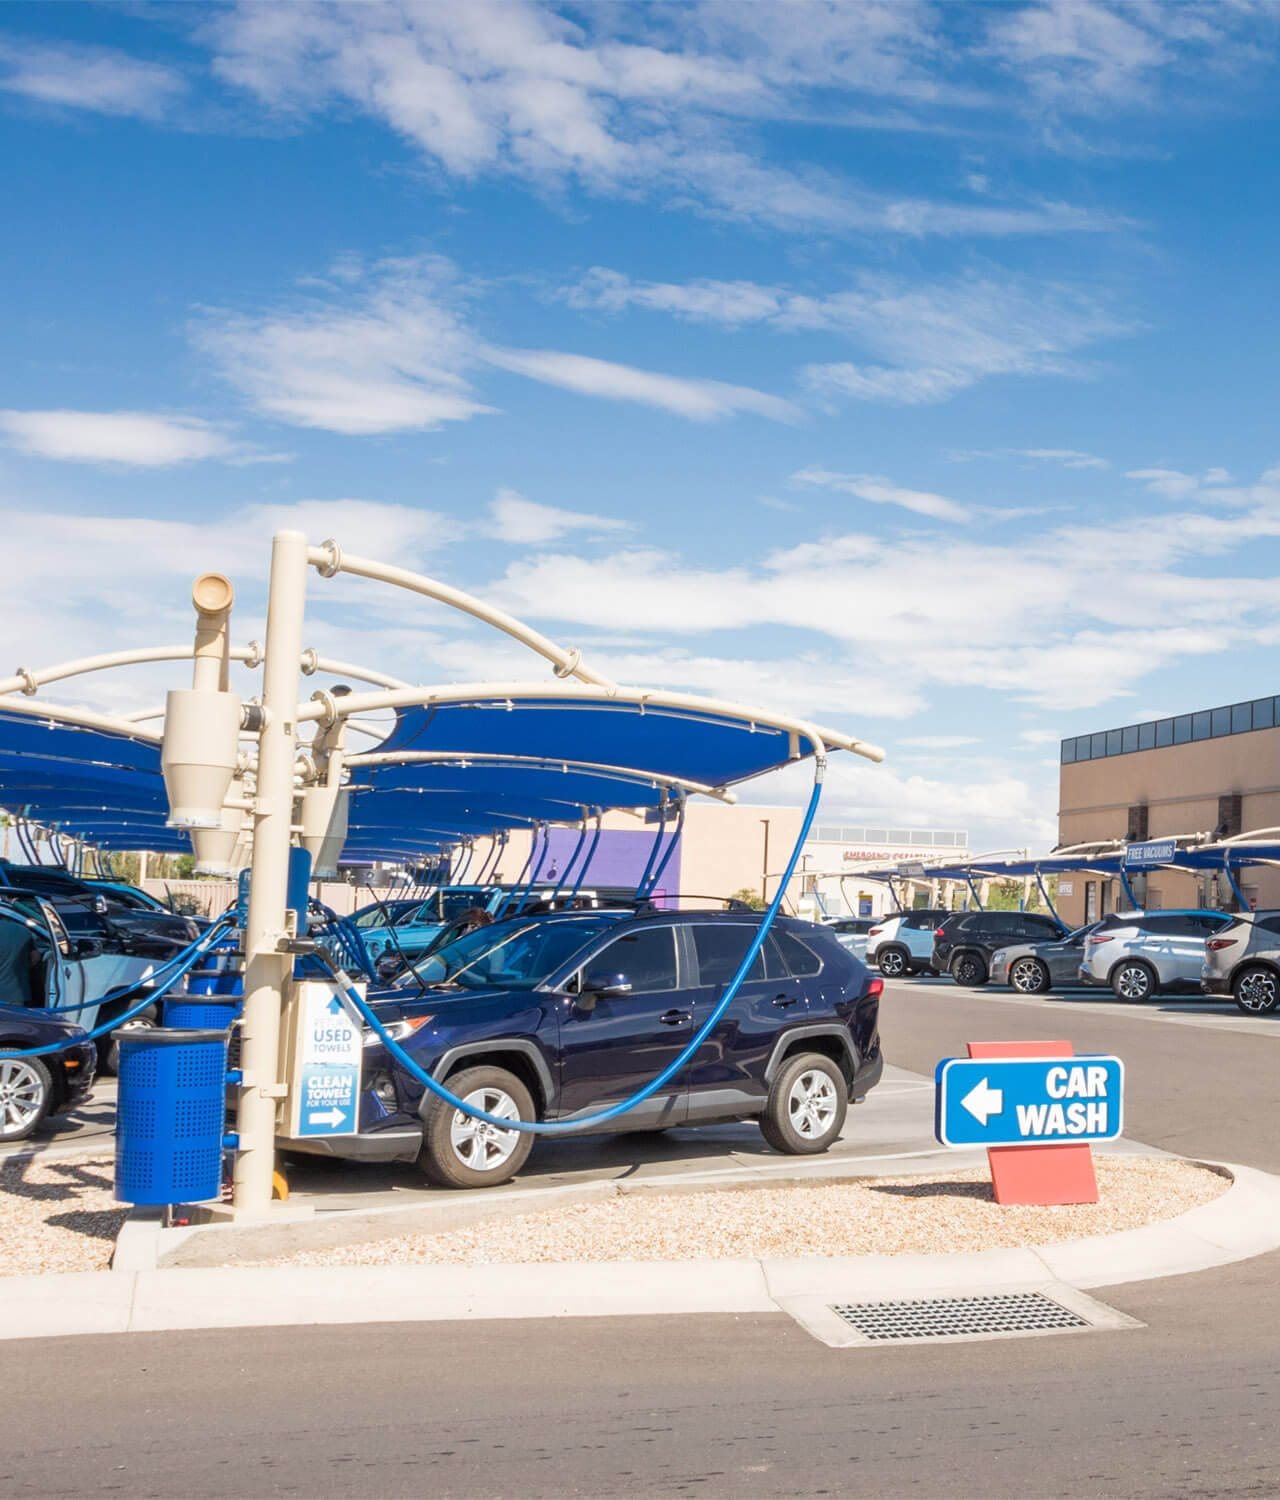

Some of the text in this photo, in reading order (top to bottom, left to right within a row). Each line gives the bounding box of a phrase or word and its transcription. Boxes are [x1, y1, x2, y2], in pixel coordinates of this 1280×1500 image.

[1127, 845, 1173, 860] FREE VACUUMS
[314, 1029, 352, 1042] USED
[314, 1043, 352, 1053] TOWELS
[307, 1075, 353, 1089] CLEAN
[1045, 1066, 1109, 1099] CAR
[307, 1088, 352, 1100] TOWELS
[1015, 1101, 1108, 1137] WASH
